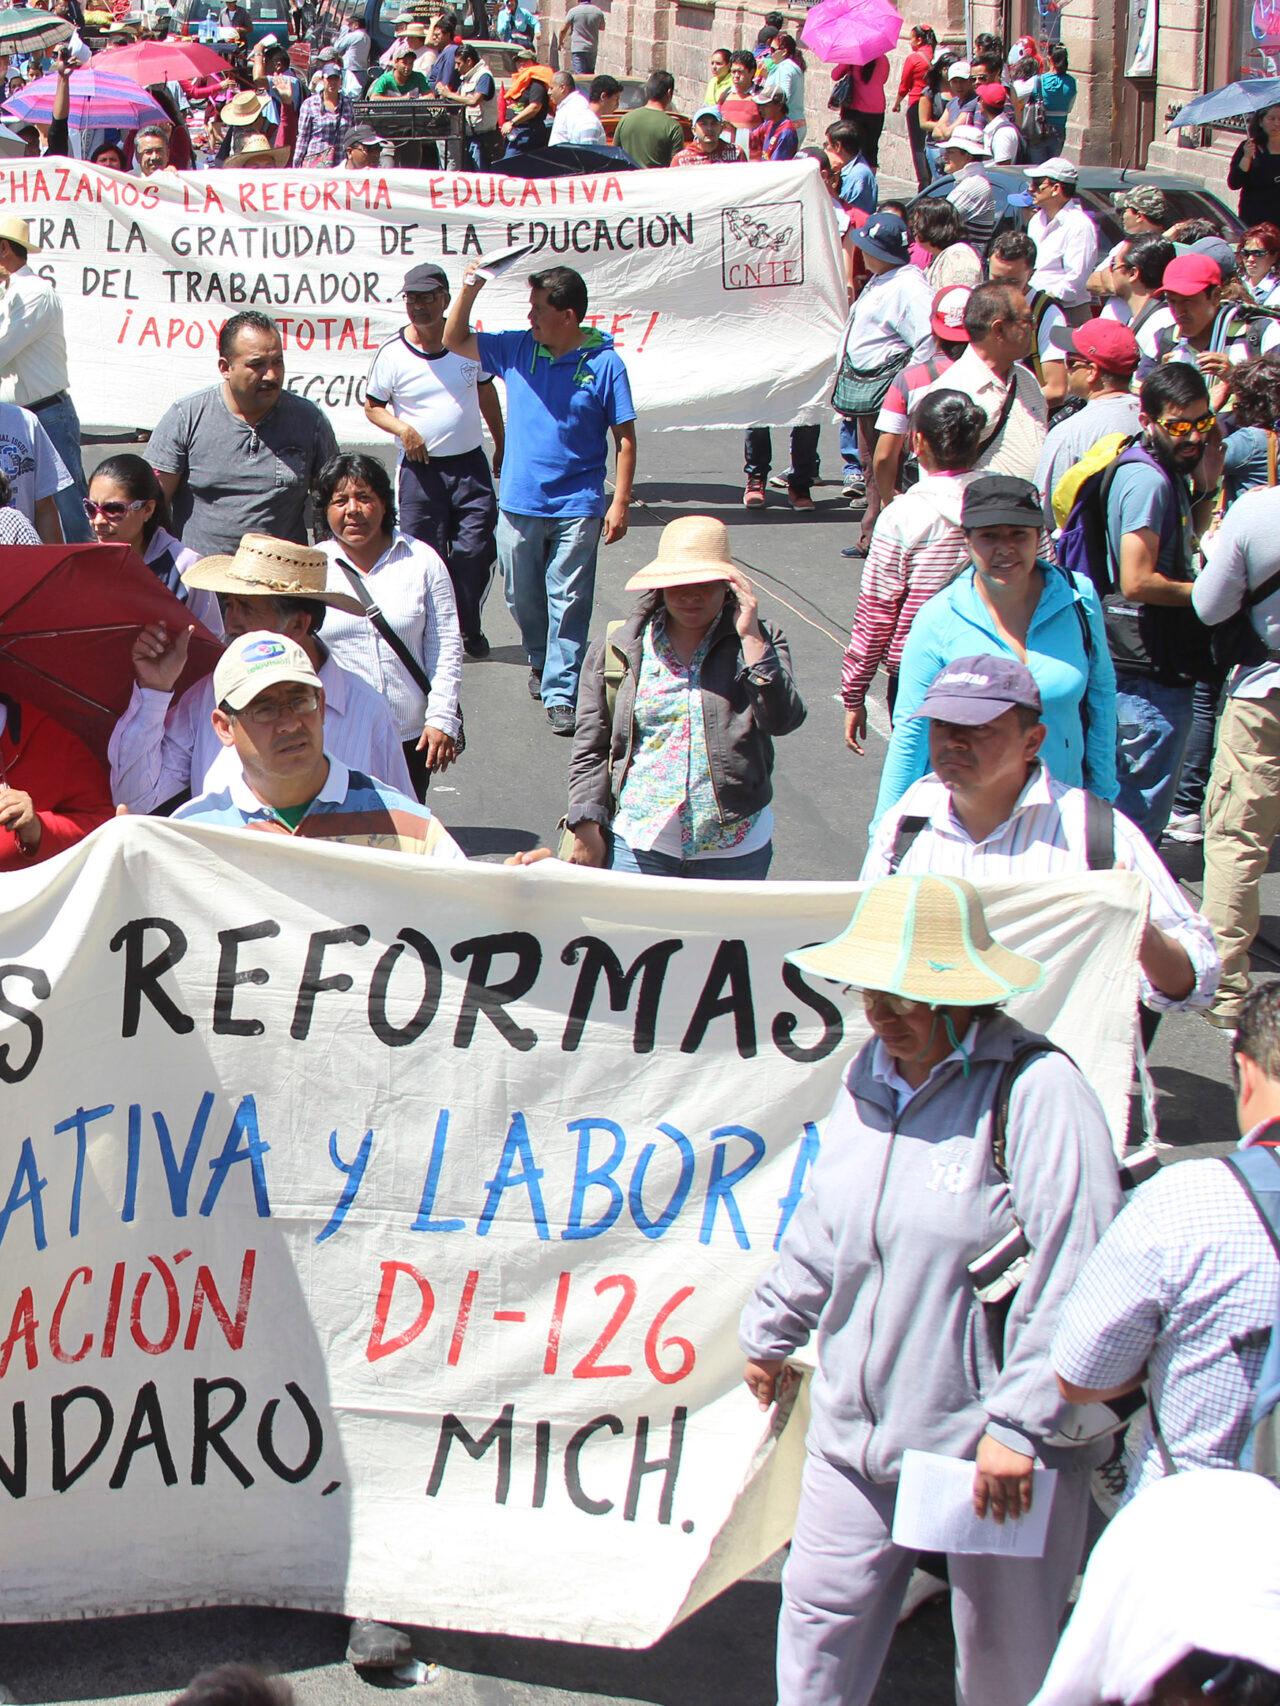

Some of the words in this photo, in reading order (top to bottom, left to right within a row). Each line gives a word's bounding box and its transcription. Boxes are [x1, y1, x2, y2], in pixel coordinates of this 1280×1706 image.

[183, 184, 225, 213] LA
[238, 177, 393, 213] REFORMA
[429, 176, 624, 209] EDUCATIVA
[107, 218, 147, 253] LA
[170, 224, 356, 259] GRATIUDAD
[380, 223, 420, 256] DE
[441, 223, 483, 255] LA
[82, 266, 140, 300] DEL
[161, 269, 393, 305] TRABAJADOR.
[729, 260, 798, 287] CNTE
[117, 309, 222, 350] ¡APOY
[274, 317, 380, 351] TOTAL
[11, 437, 29, 455] ISSUE
[109, 916, 844, 1063] REFORMAS
[425, 1403, 695, 1534] MICH.
